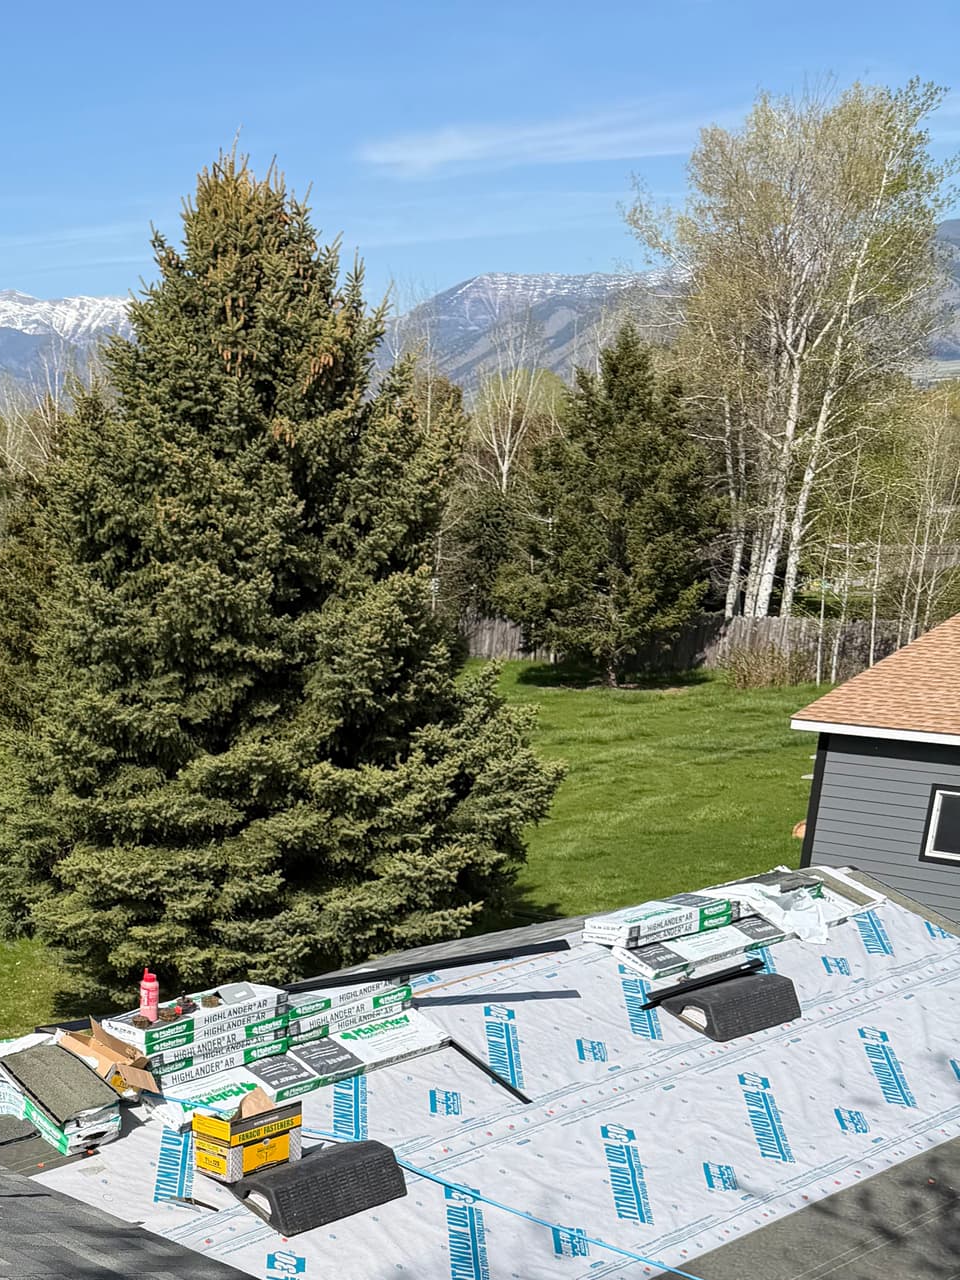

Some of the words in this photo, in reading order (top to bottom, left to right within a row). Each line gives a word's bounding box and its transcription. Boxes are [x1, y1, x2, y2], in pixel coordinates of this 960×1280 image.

[264, 1118, 294, 1135] FASTENERS
[605, 1121, 629, 1145] 30
[603, 1140, 626, 1166] UDL
[608, 1164, 638, 1223] TITANIUM
[445, 1204, 468, 1228] UDL
[273, 1250, 296, 1273] 30
